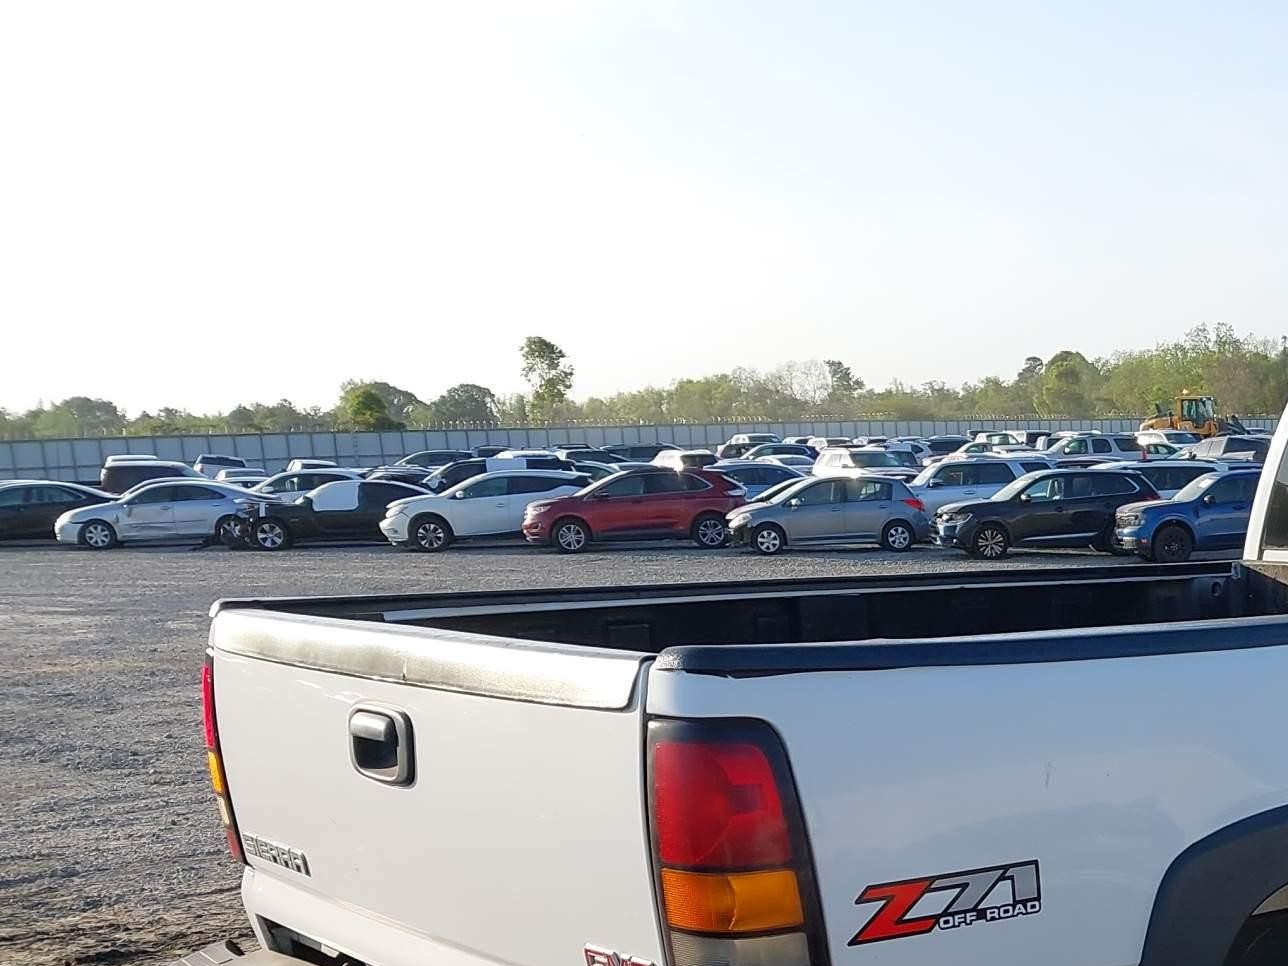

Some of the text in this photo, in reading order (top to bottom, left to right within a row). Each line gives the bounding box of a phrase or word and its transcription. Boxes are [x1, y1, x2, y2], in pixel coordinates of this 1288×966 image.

[241, 832, 312, 878] SIERRA
[847, 858, 1041, 947] Z71
[938, 900, 1041, 930] OFF ROAD
